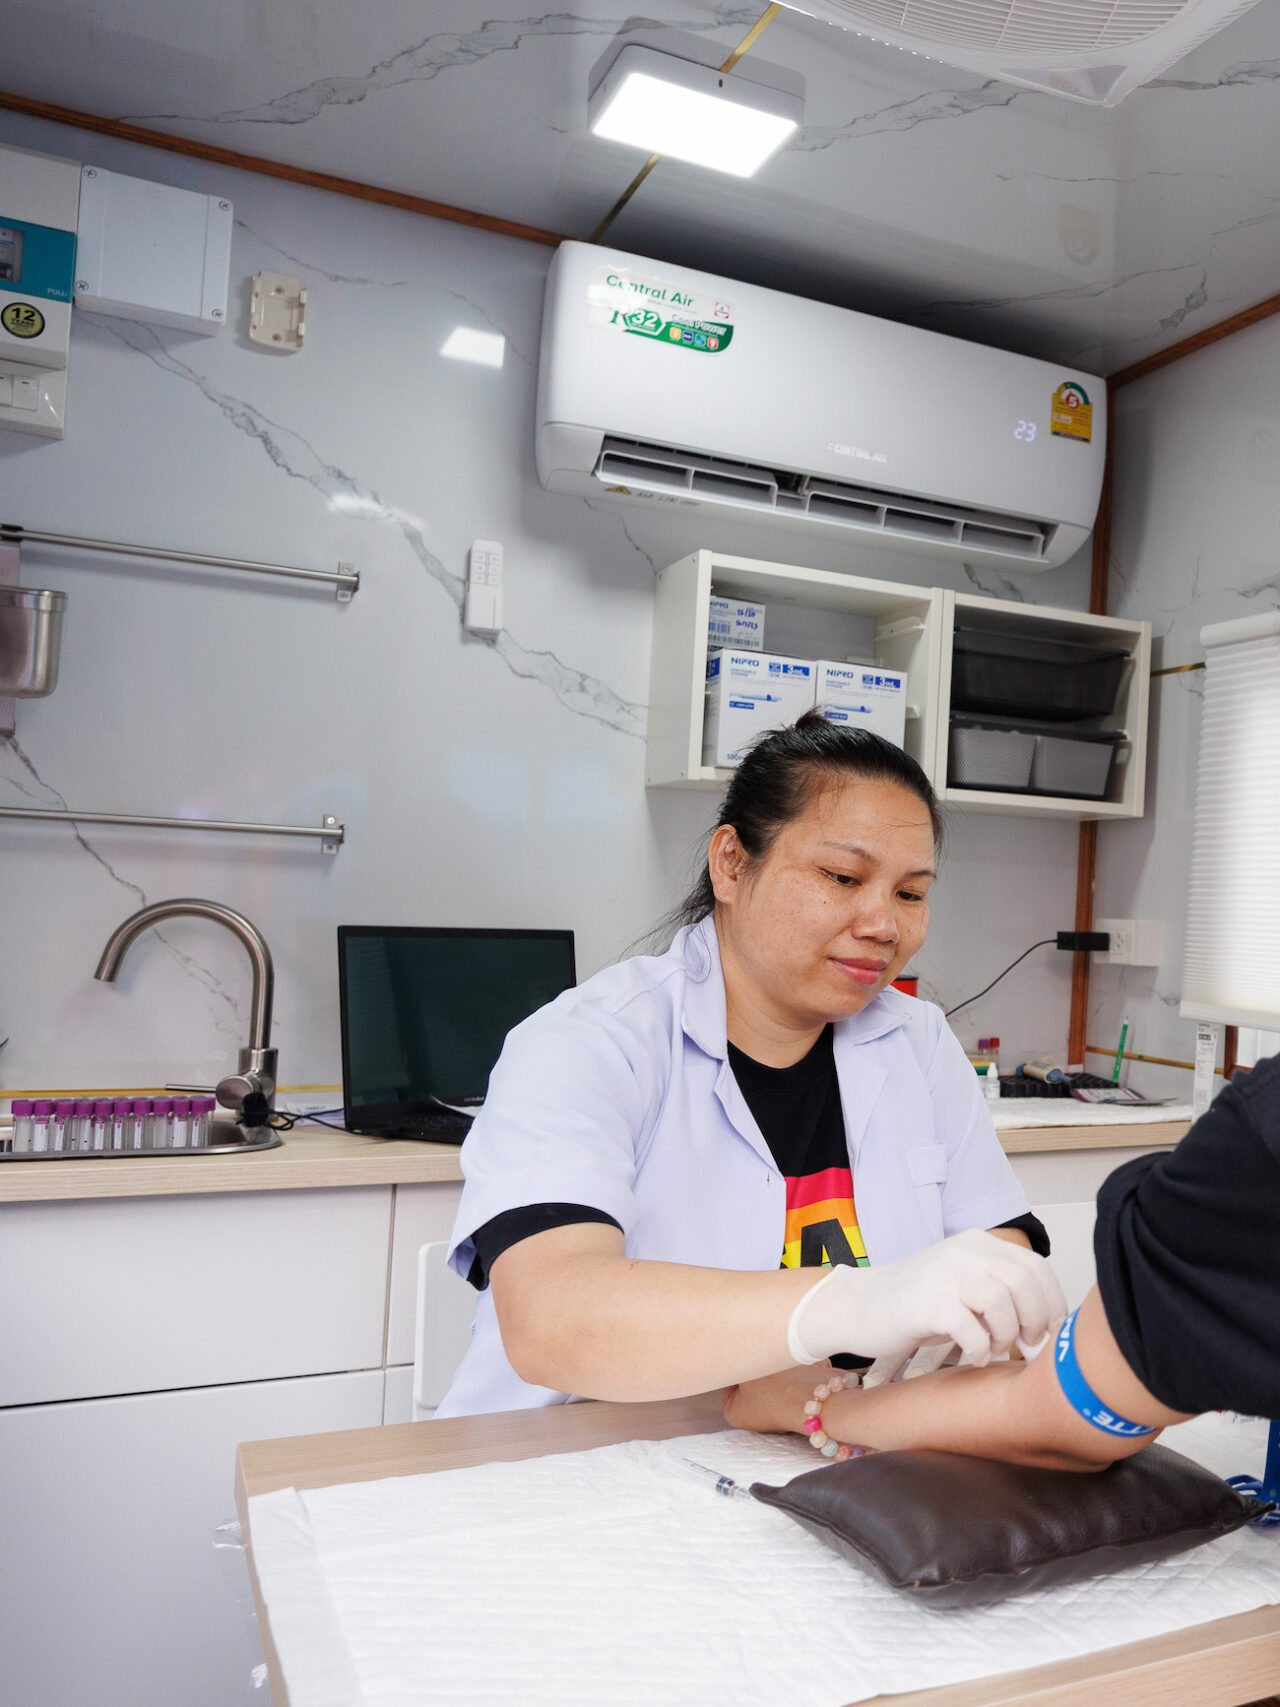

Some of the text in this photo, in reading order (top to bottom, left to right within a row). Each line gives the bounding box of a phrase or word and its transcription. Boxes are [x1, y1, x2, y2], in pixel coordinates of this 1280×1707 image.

[670, 292, 695, 307] Air
[11, 307, 36, 322] 12
[1014, 419, 1037, 442] 23
[730, 657, 760, 667] NIPRO
[826, 668, 854, 679] NIPRO
